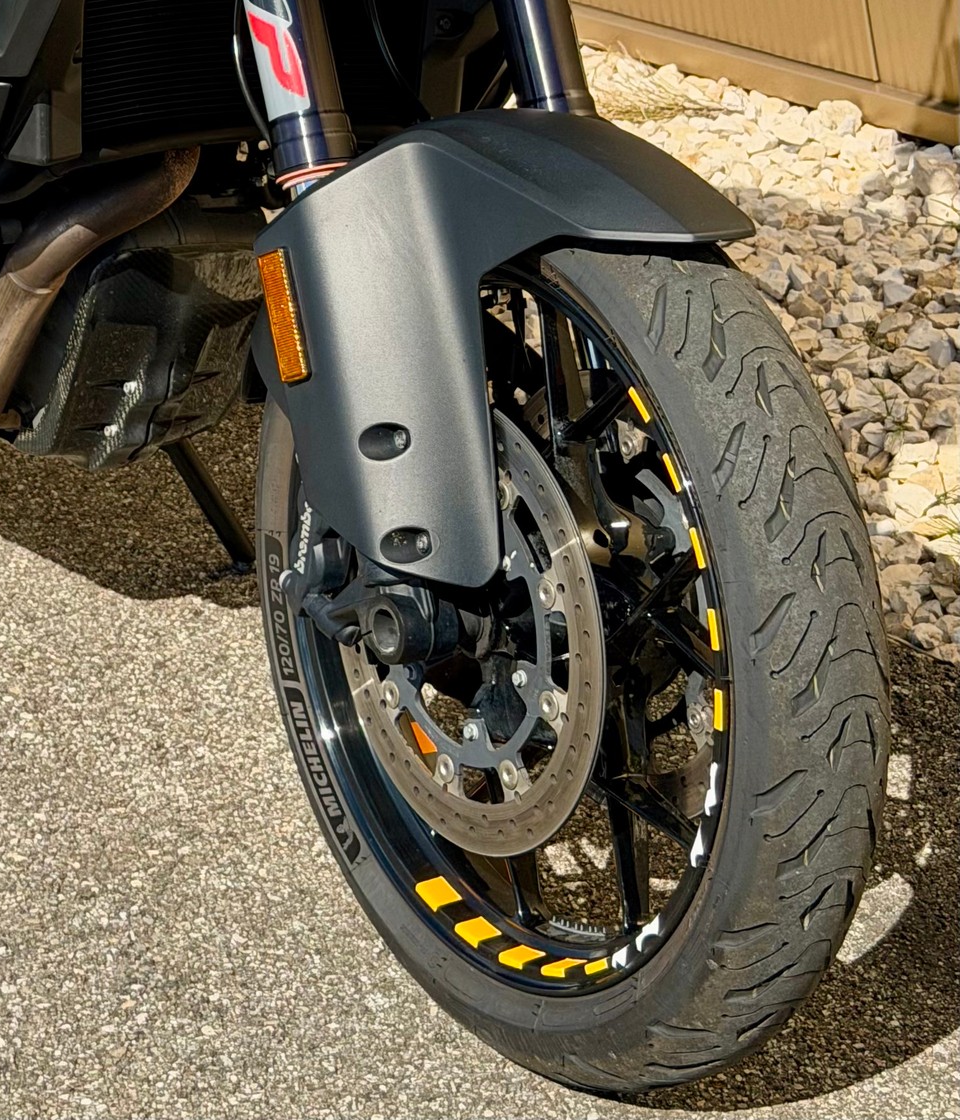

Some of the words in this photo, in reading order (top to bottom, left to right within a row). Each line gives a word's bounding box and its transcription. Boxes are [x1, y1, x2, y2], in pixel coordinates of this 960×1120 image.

[268, 553, 281, 574] 19
[270, 578, 283, 606] ZR
[273, 610, 295, 676] 120/70
[290, 701, 342, 817] MICHELIN
